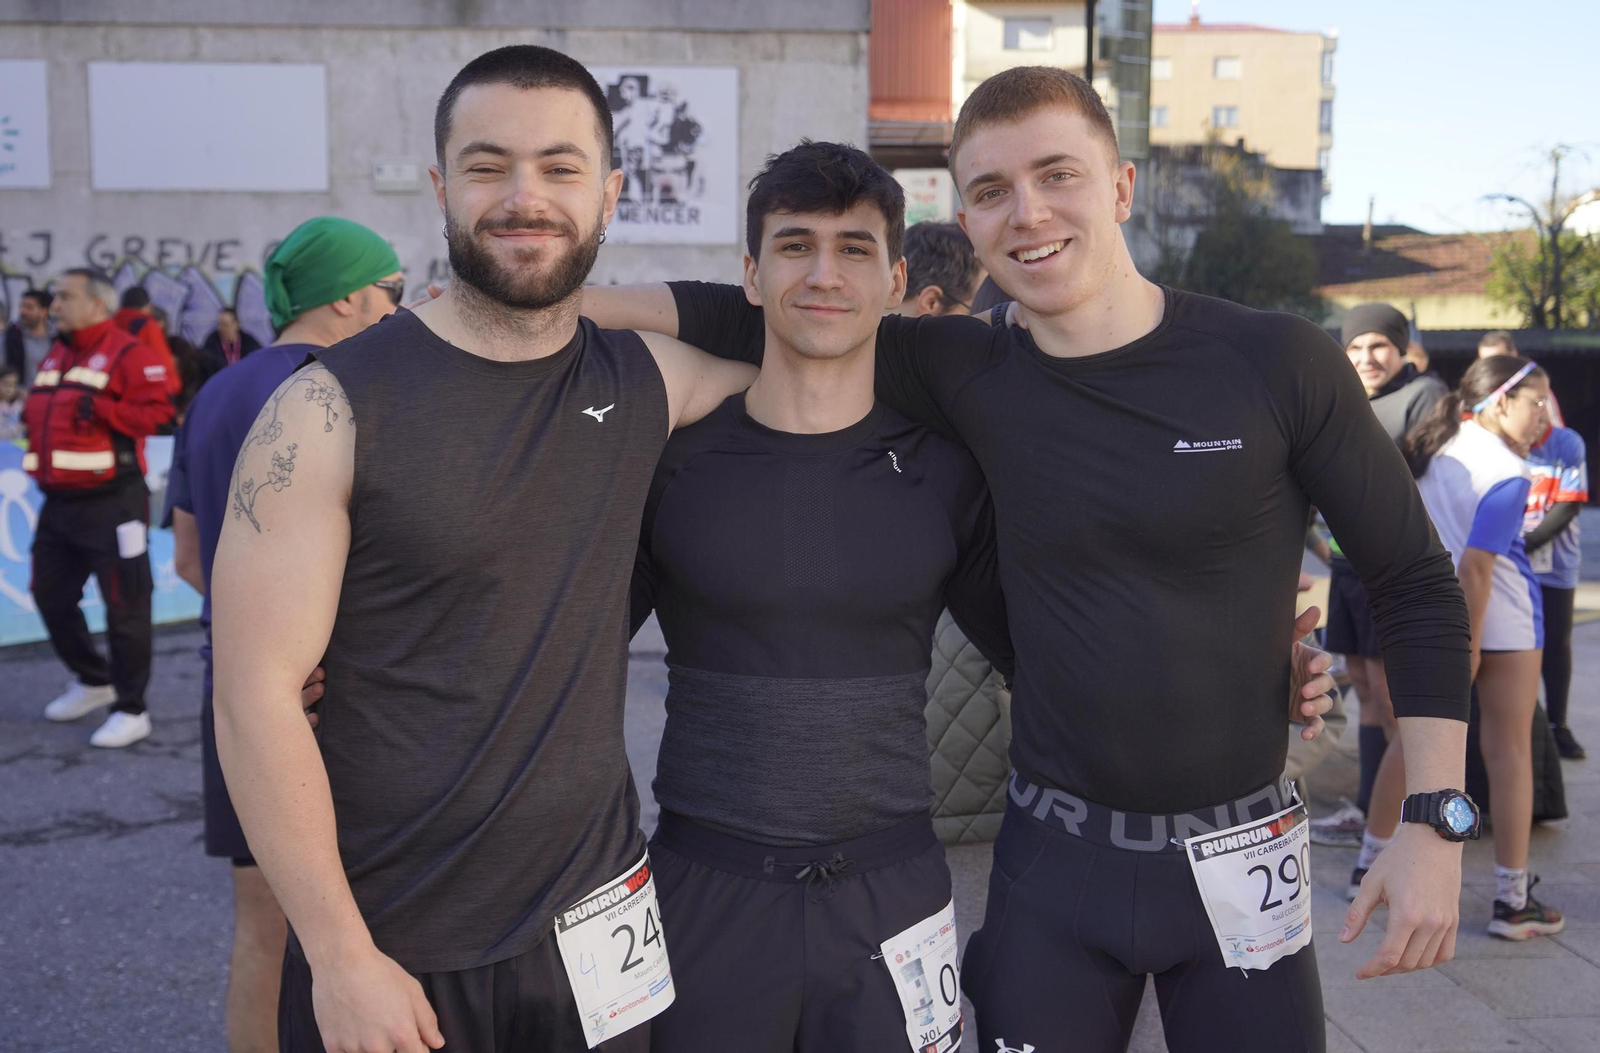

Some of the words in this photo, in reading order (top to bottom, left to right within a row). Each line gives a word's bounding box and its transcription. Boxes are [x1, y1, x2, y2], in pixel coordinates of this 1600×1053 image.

[1193, 438, 1242, 448] MOUNTAIN
[1243, 850, 1256, 860] VII
[1257, 836, 1292, 856] CARREIRA
[1247, 842, 1310, 912] 290
[605, 913, 617, 922] VII
[617, 890, 648, 916] CARREIRA
[1272, 910, 1285, 922] Raúl
[1255, 936, 1286, 953] Santander
[580, 952, 600, 990] 4
[634, 966, 653, 980] Mauro
[617, 993, 650, 1015] Santander
[920, 1025, 941, 1045] 10K
